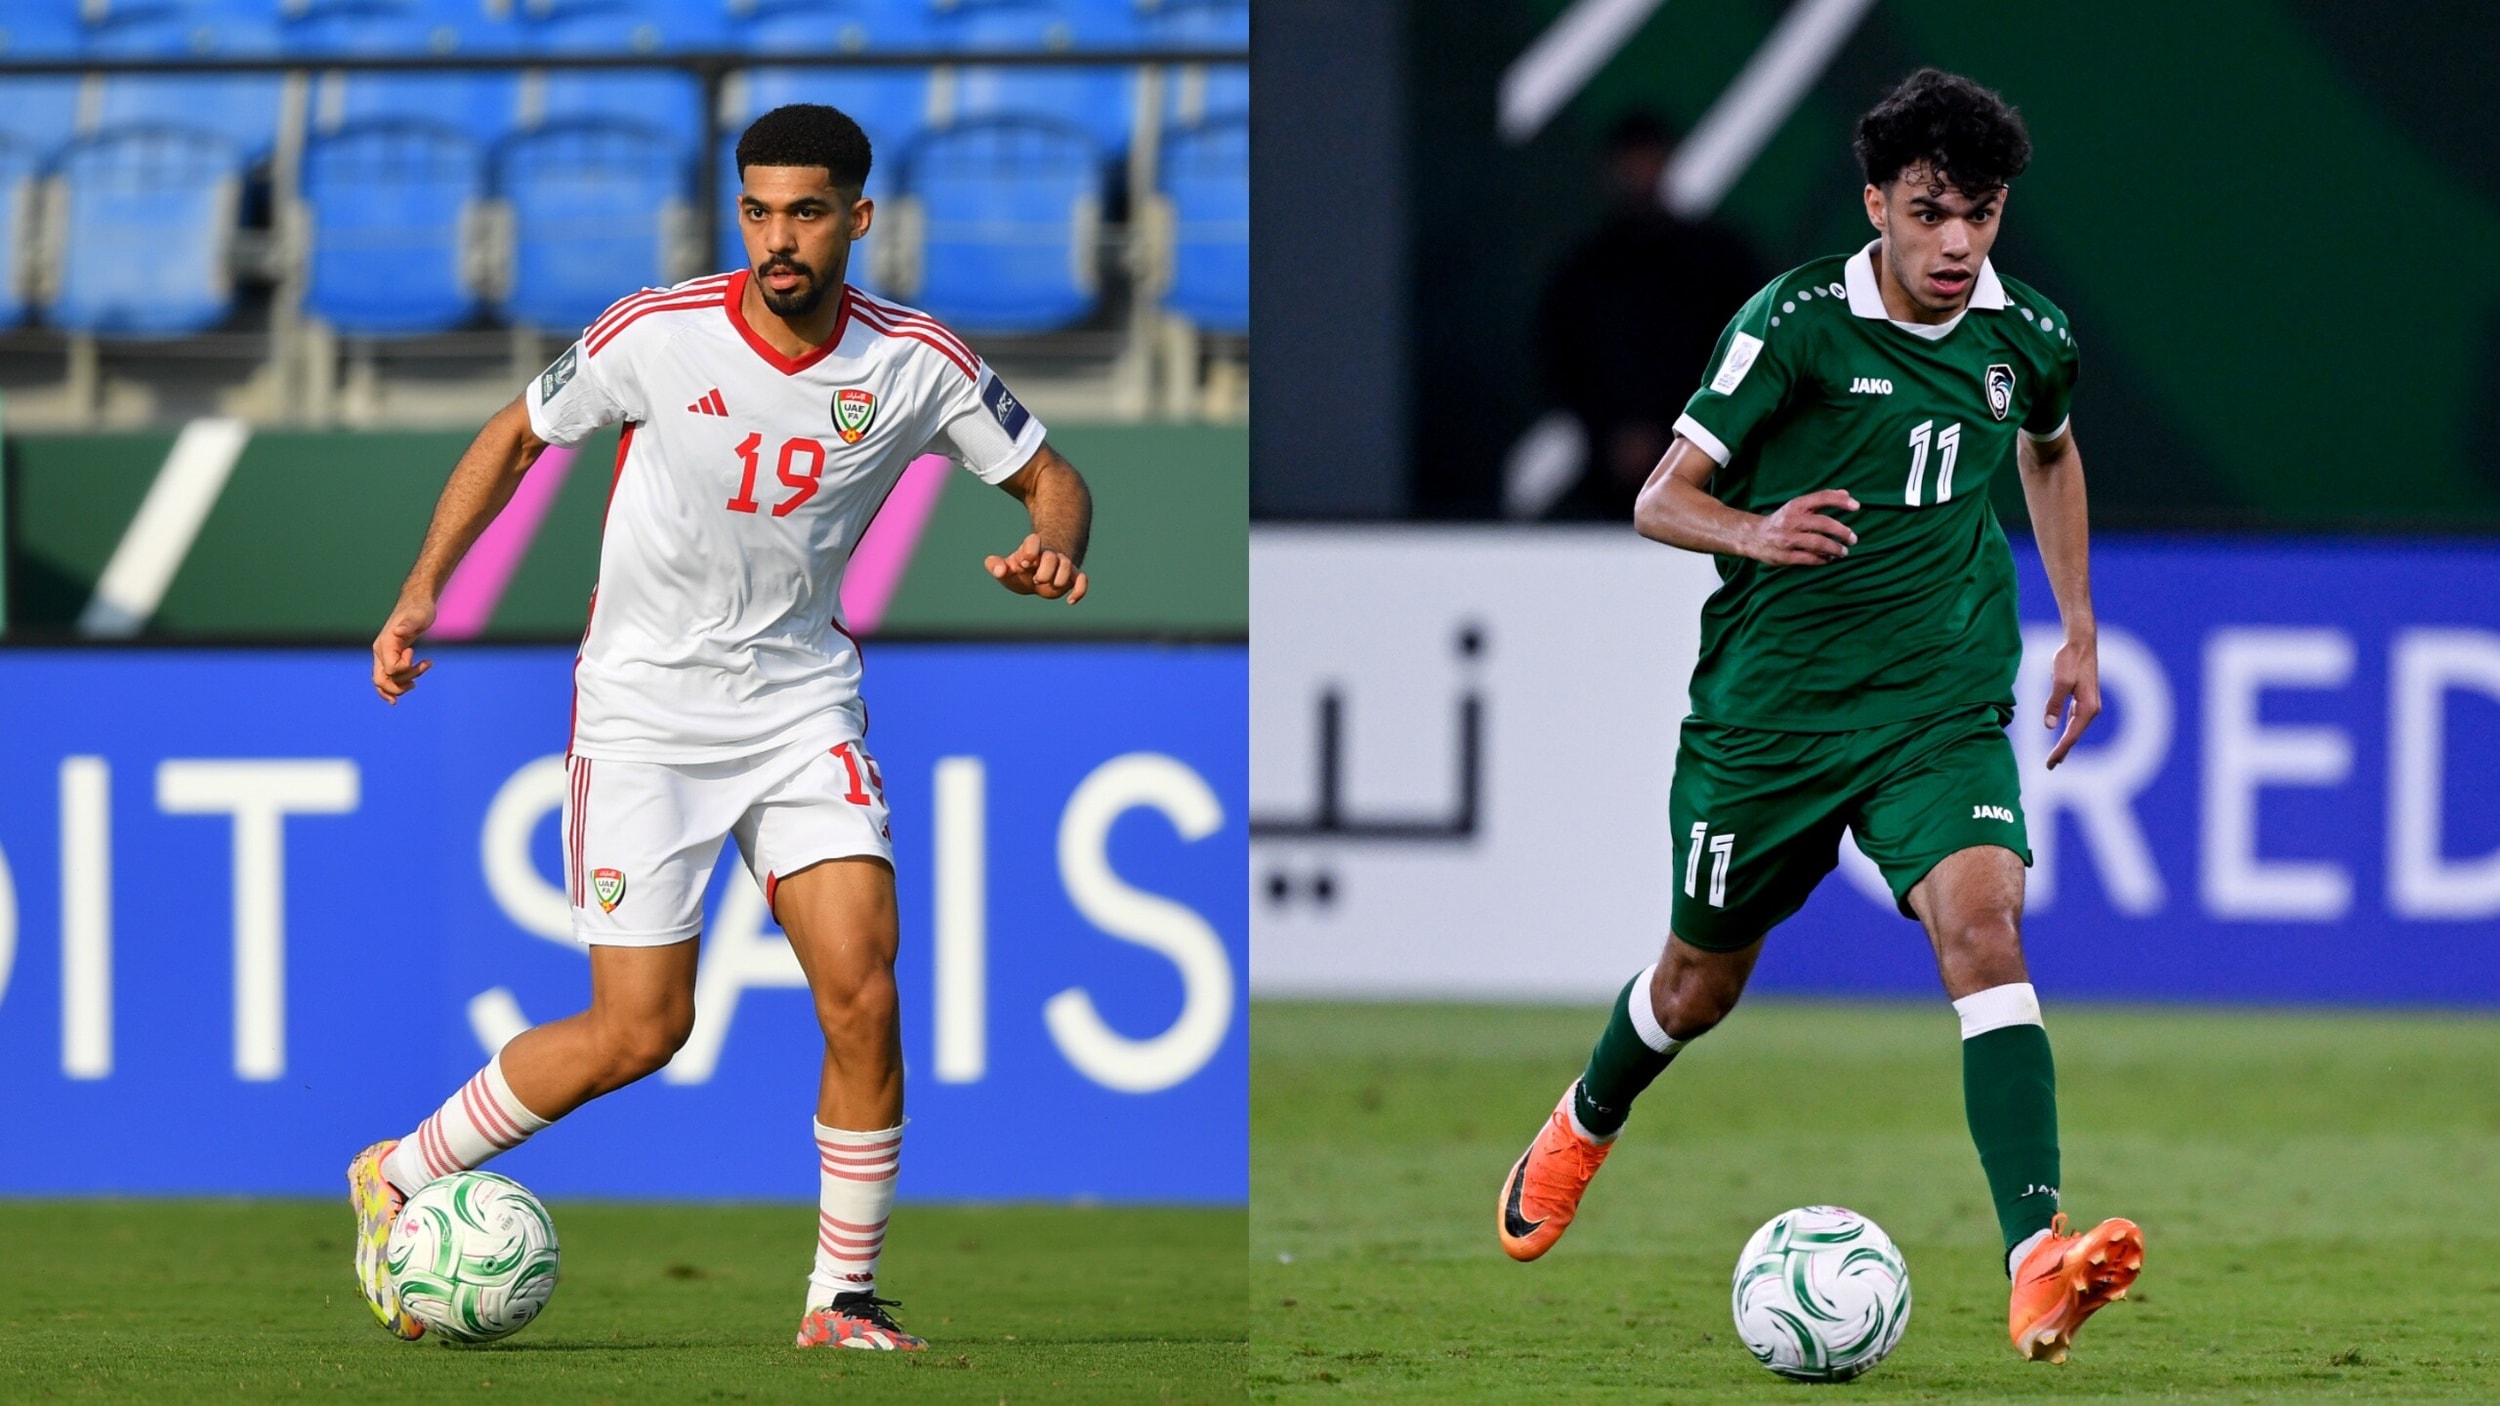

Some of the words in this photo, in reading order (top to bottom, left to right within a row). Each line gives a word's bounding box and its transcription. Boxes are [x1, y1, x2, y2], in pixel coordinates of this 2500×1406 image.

[844, 403, 865, 412] UAE
[1849, 377, 1893, 395] JAKO
[726, 432, 825, 517] 19
[1904, 420, 1961, 506] 11
[1972, 805, 2014, 823] JAKO
[1684, 822, 1736, 908] 11
[0, 754, 362, 1082] IT
